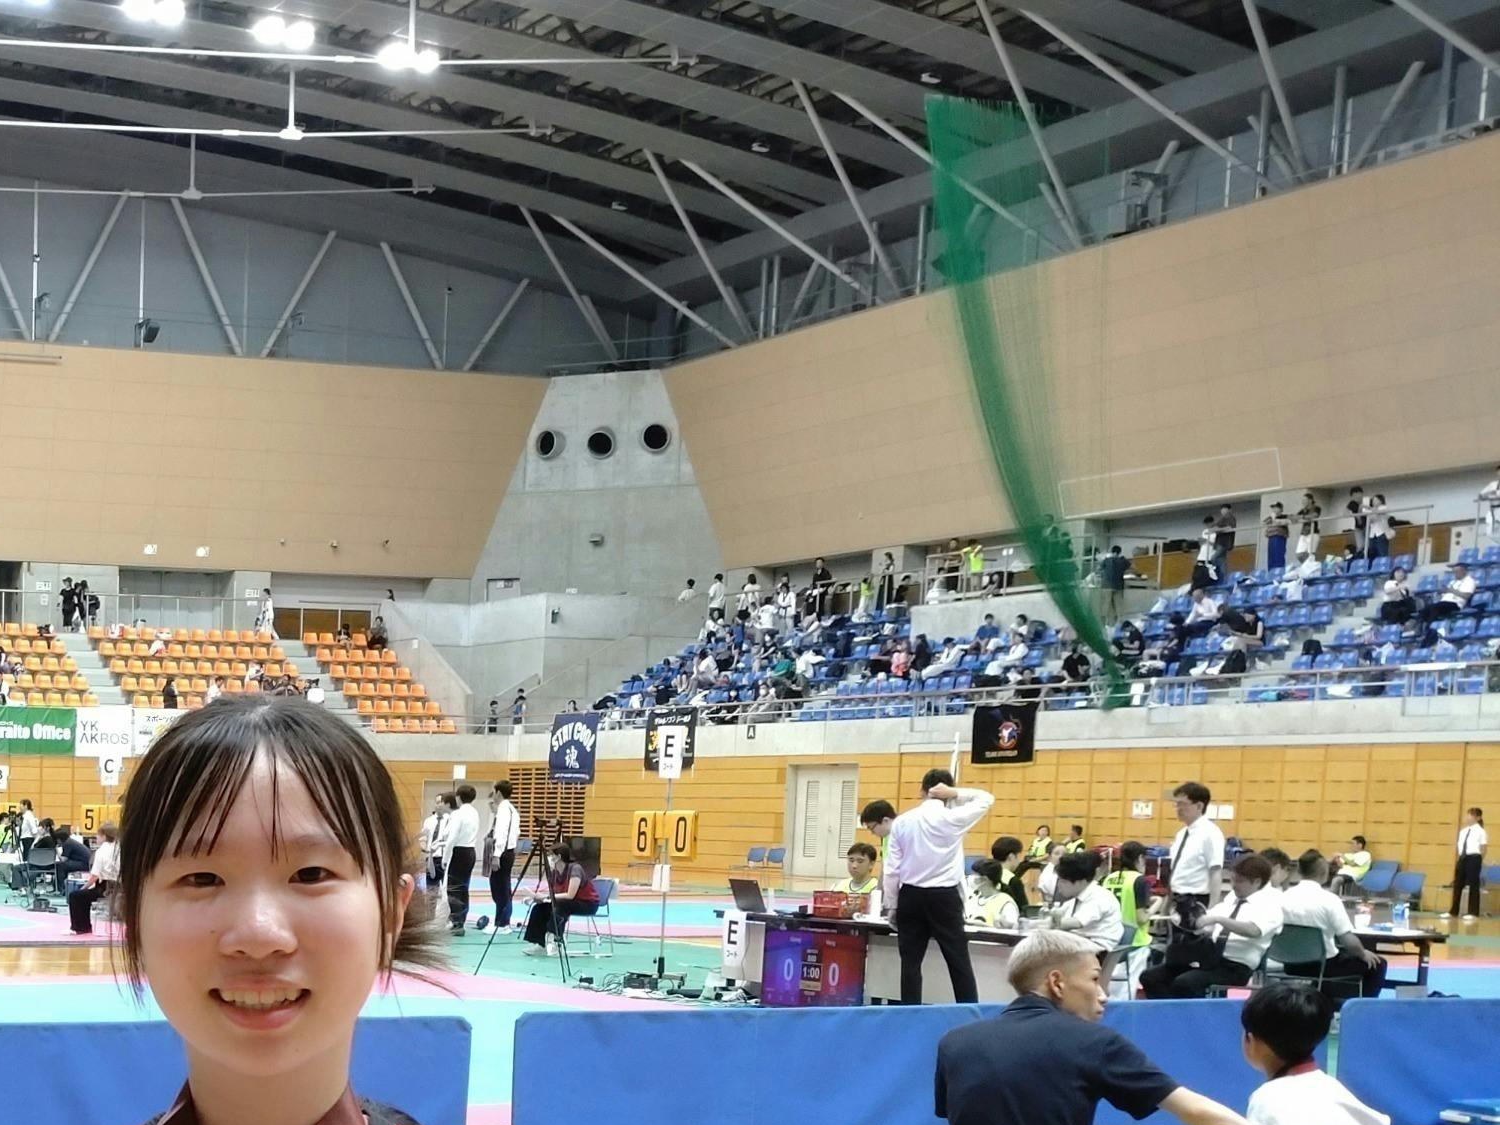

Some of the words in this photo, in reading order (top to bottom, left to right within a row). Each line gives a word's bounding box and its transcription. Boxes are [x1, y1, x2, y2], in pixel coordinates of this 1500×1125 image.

[33, 722, 71, 741] Office
[80, 721, 98, 732] YK
[552, 722, 575, 752] STAY
[573, 722, 596, 752] COOL
[664, 735, 675, 758] E
[104, 759, 114, 774] C
[84, 809, 95, 830] 5
[637, 817, 648, 852] 6
[675, 816, 687, 853] 0
[727, 920, 739, 945] E
[784, 958, 794, 981] 0
[802, 967, 820, 979] 1:00
[828, 962, 840, 986] 0
